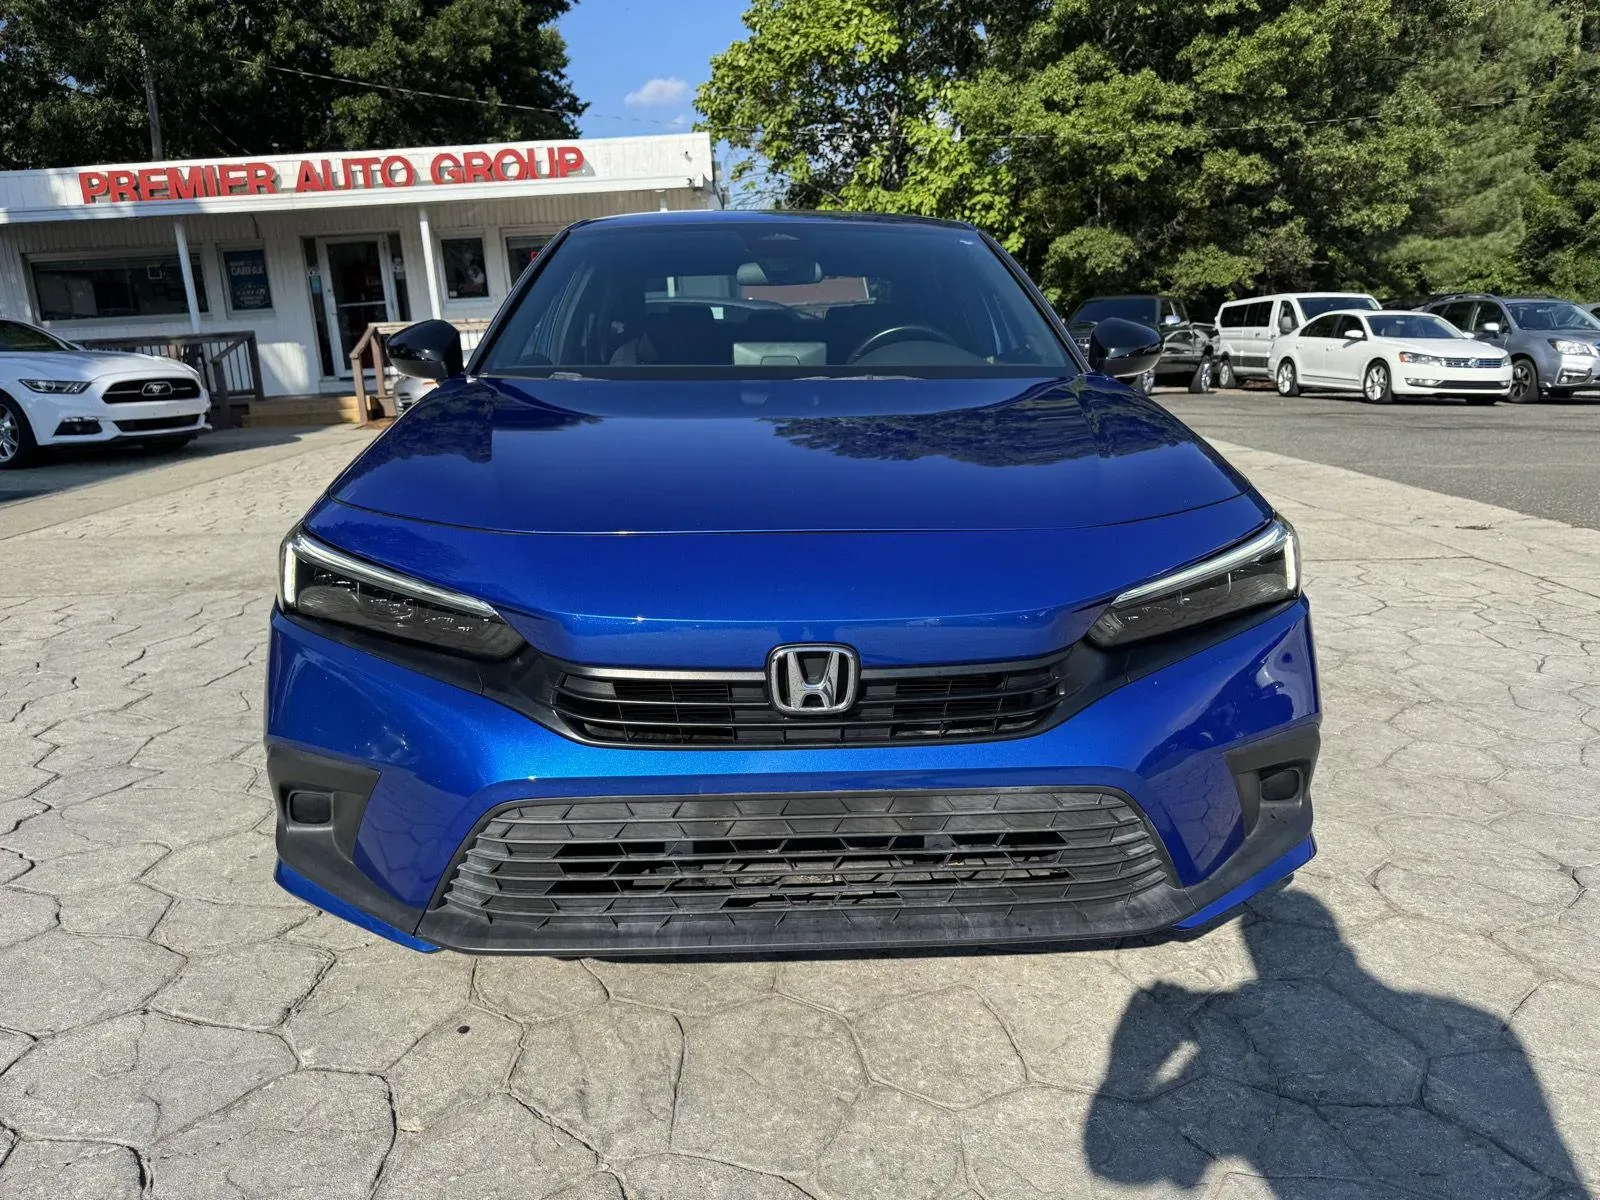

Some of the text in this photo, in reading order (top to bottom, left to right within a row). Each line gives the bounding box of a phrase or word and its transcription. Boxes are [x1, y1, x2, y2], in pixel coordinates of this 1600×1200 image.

[79, 146, 585, 204] PREMIER AUTO GROUP
